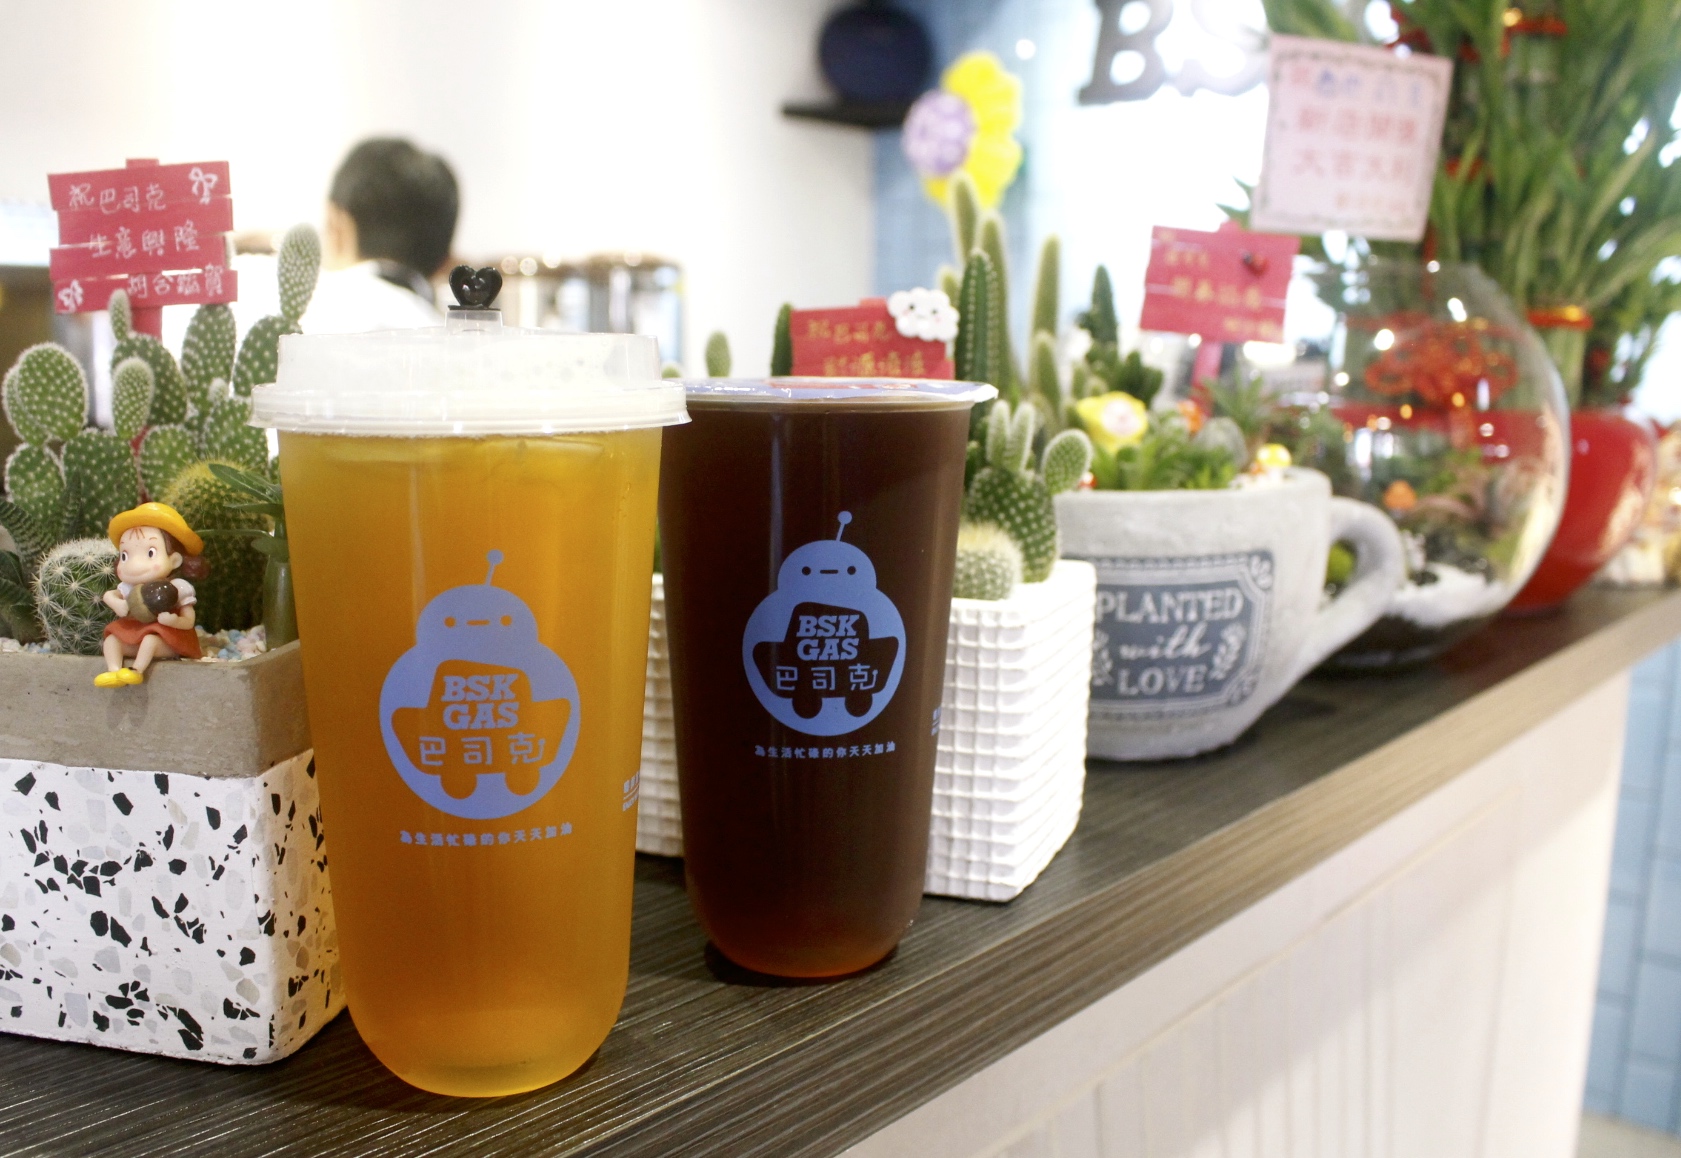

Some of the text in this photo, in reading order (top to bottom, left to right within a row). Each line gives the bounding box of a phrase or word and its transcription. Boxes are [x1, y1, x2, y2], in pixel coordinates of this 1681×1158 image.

[69, 183, 166, 215] 祝巴司克
[89, 219, 199, 259] 生意興隆
[1096, 587, 1244, 623] PLANTED
[796, 615, 859, 638] BSK
[797, 638, 859, 661] GAS
[441, 674, 519, 702] BSK
[775, 663, 879, 692] 巴司克
[1117, 664, 1208, 696] LOVE
[442, 702, 519, 730] GAS
[418, 732, 546, 767] 巴司克
[754, 740, 896, 760] 為生活忙碌的你天天加油
[399, 821, 573, 848] 為生活忙碌的你天天加油
